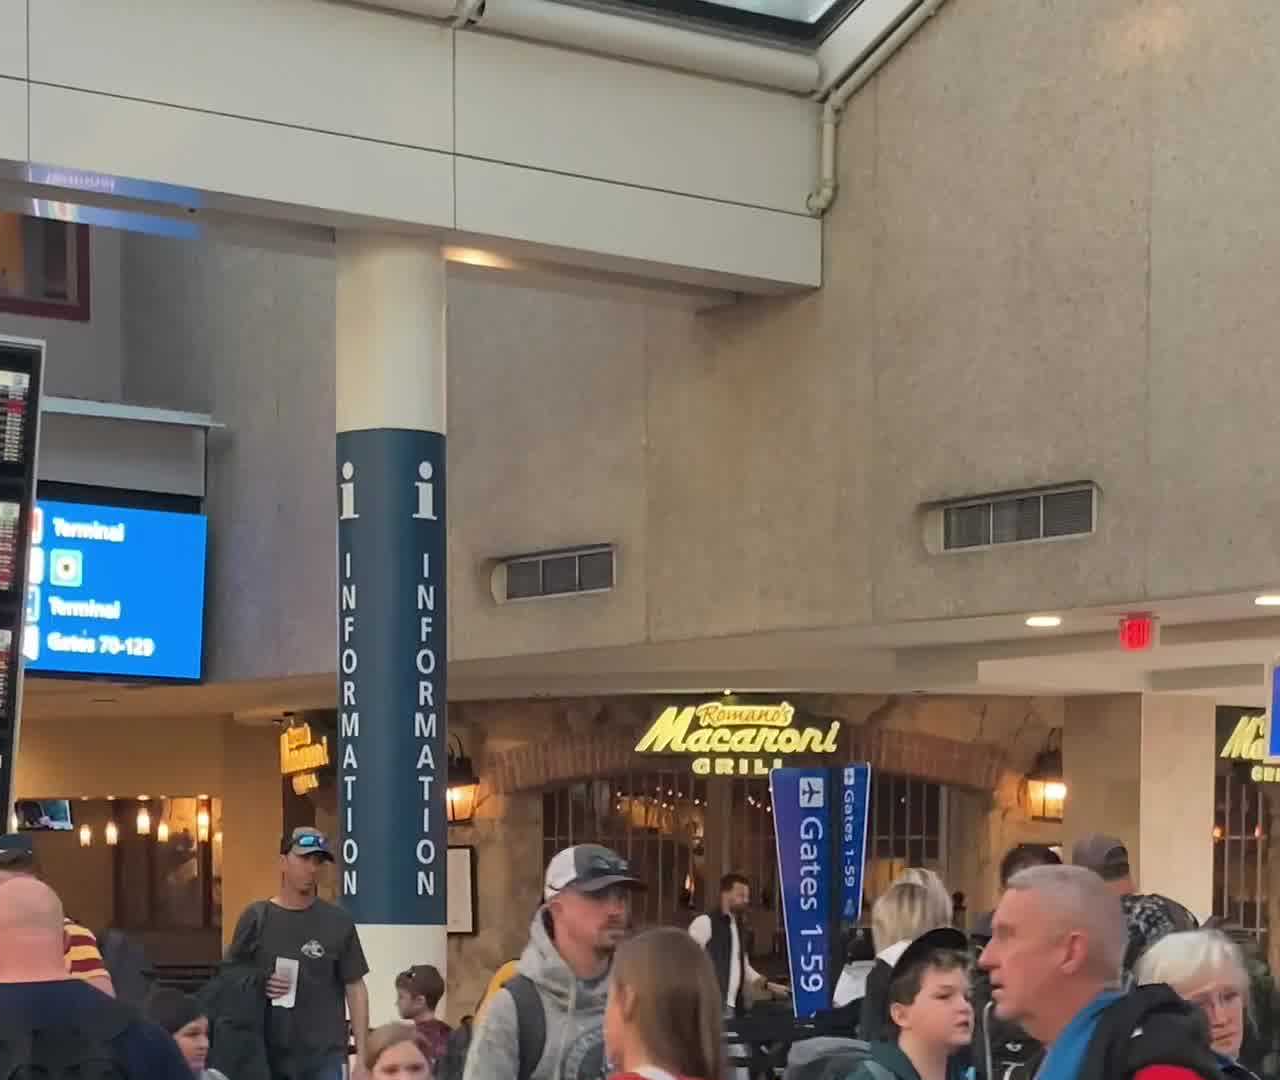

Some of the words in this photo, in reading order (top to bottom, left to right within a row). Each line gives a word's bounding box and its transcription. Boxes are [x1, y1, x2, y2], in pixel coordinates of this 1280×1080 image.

[52, 517, 126, 543] Terminal
[48, 595, 122, 620] Terminal
[47, 631, 96, 654] Gates
[99, 634, 156, 657] 70-129
[340, 552, 360, 896] INFORMATION
[414, 552, 437, 896] INFORMATION
[634, 706, 841, 754] Macaroni
[699, 704, 793, 725] Romano's
[843, 789, 855, 843] Gates
[800, 816, 824, 911] Gates
[843, 849, 855, 887] 1-59
[800, 924, 824, 993] 1-59
